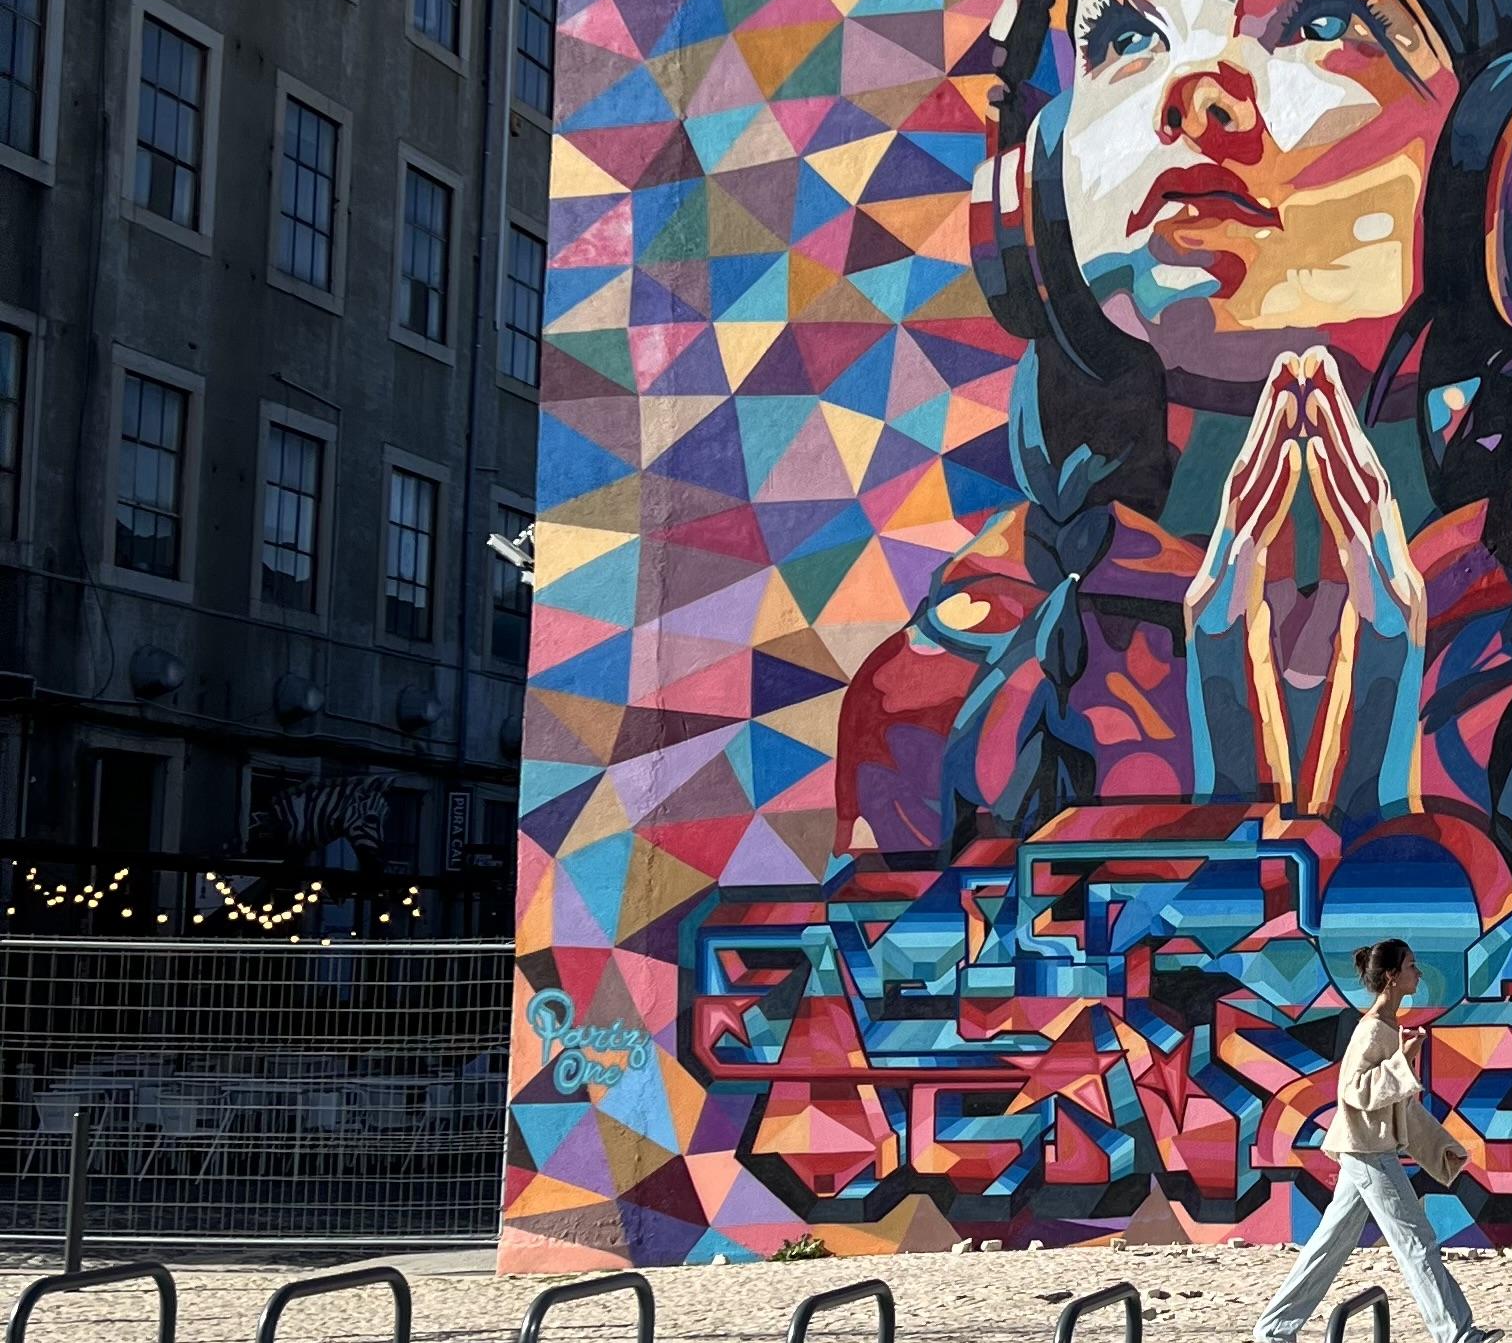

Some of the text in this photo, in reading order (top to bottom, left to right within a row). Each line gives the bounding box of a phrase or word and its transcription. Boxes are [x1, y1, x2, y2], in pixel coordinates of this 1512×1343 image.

[452, 798, 464, 834] PURA
[526, 987, 653, 1070] Pariz
[553, 1048, 625, 1095] One
